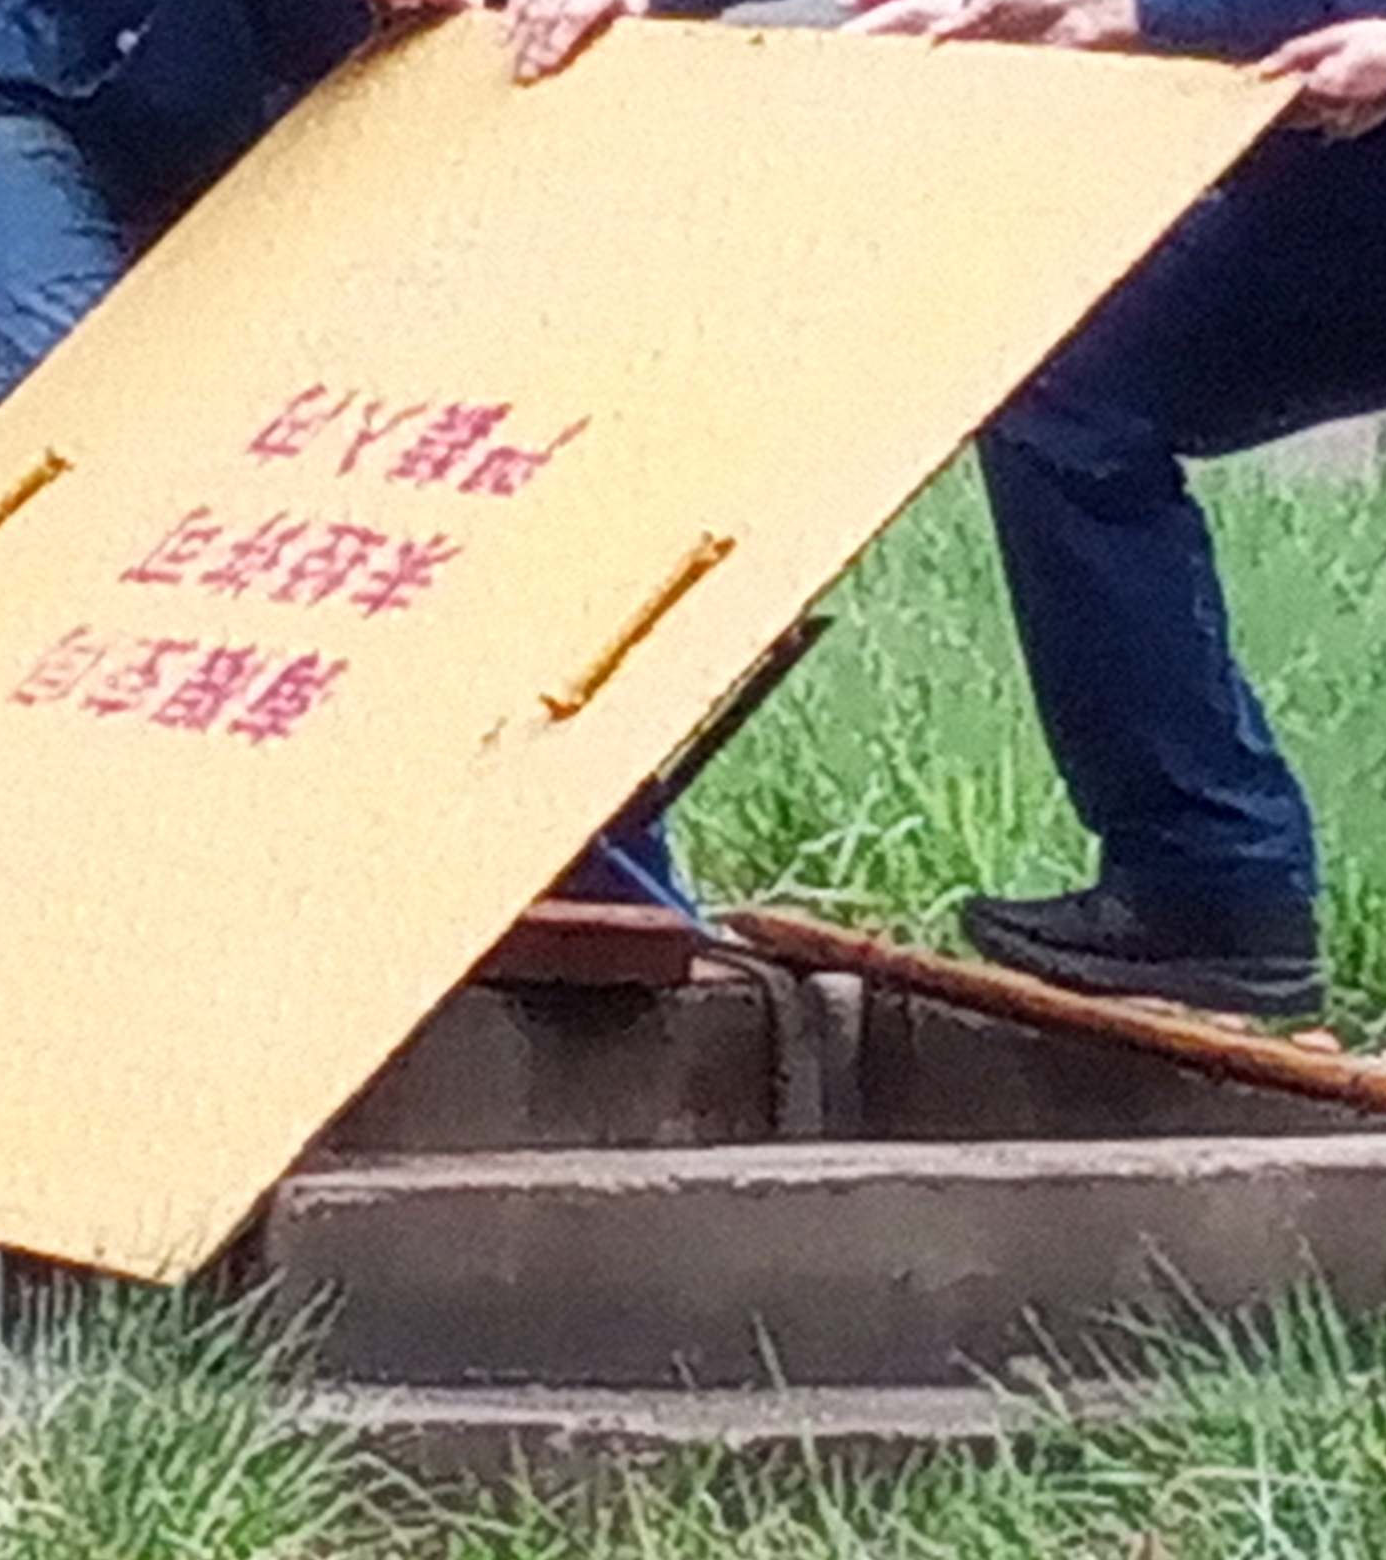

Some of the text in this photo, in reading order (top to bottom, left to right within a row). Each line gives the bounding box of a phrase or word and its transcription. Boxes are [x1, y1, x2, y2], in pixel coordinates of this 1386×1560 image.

[246, 383, 591, 496] 严禁入内
[117, 505, 464, 619] 未经许可
[10, 624, 349, 745] 有限空间
